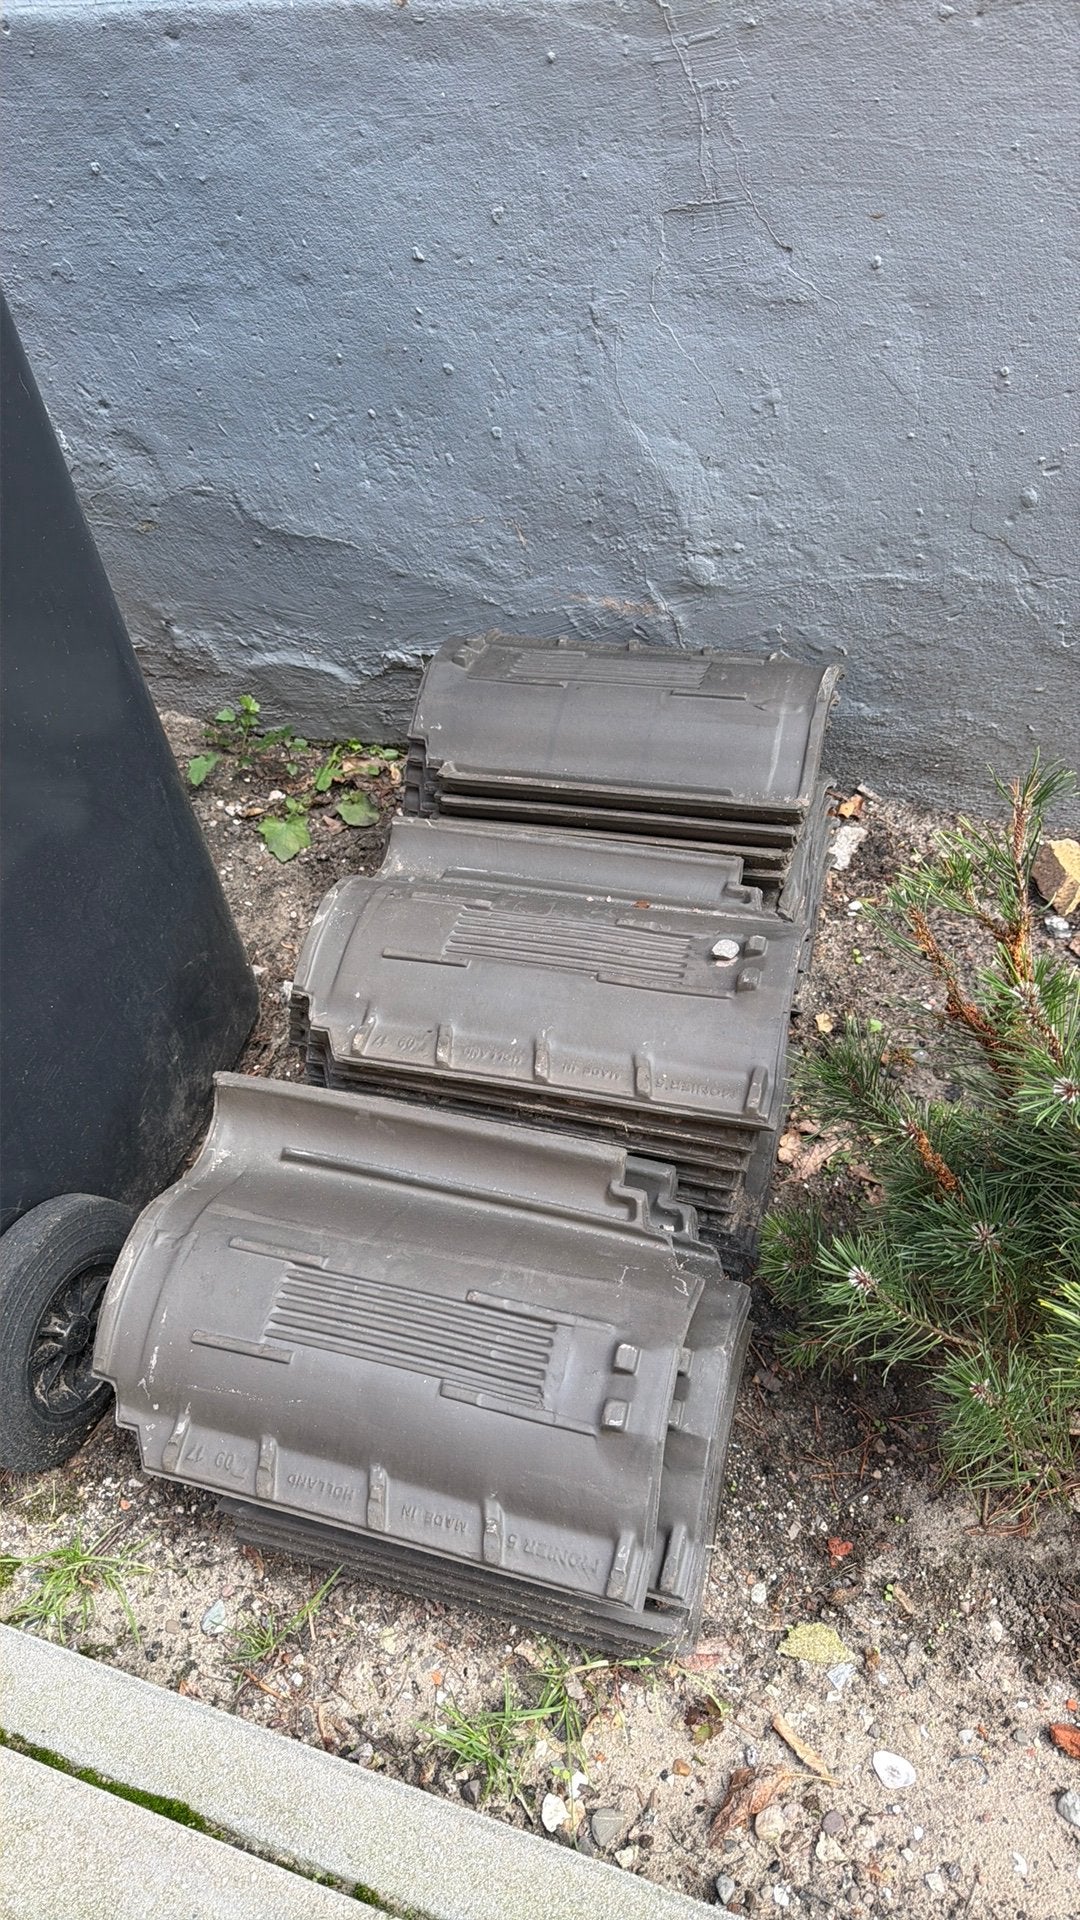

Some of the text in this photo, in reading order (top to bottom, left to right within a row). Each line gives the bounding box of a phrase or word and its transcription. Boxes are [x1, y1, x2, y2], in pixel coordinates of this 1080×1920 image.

[286, 1472, 359, 1501] HOLLAND
[401, 1503, 417, 1520] IN
[423, 1512, 468, 1537] MADE
[506, 1532, 519, 1550] 5
